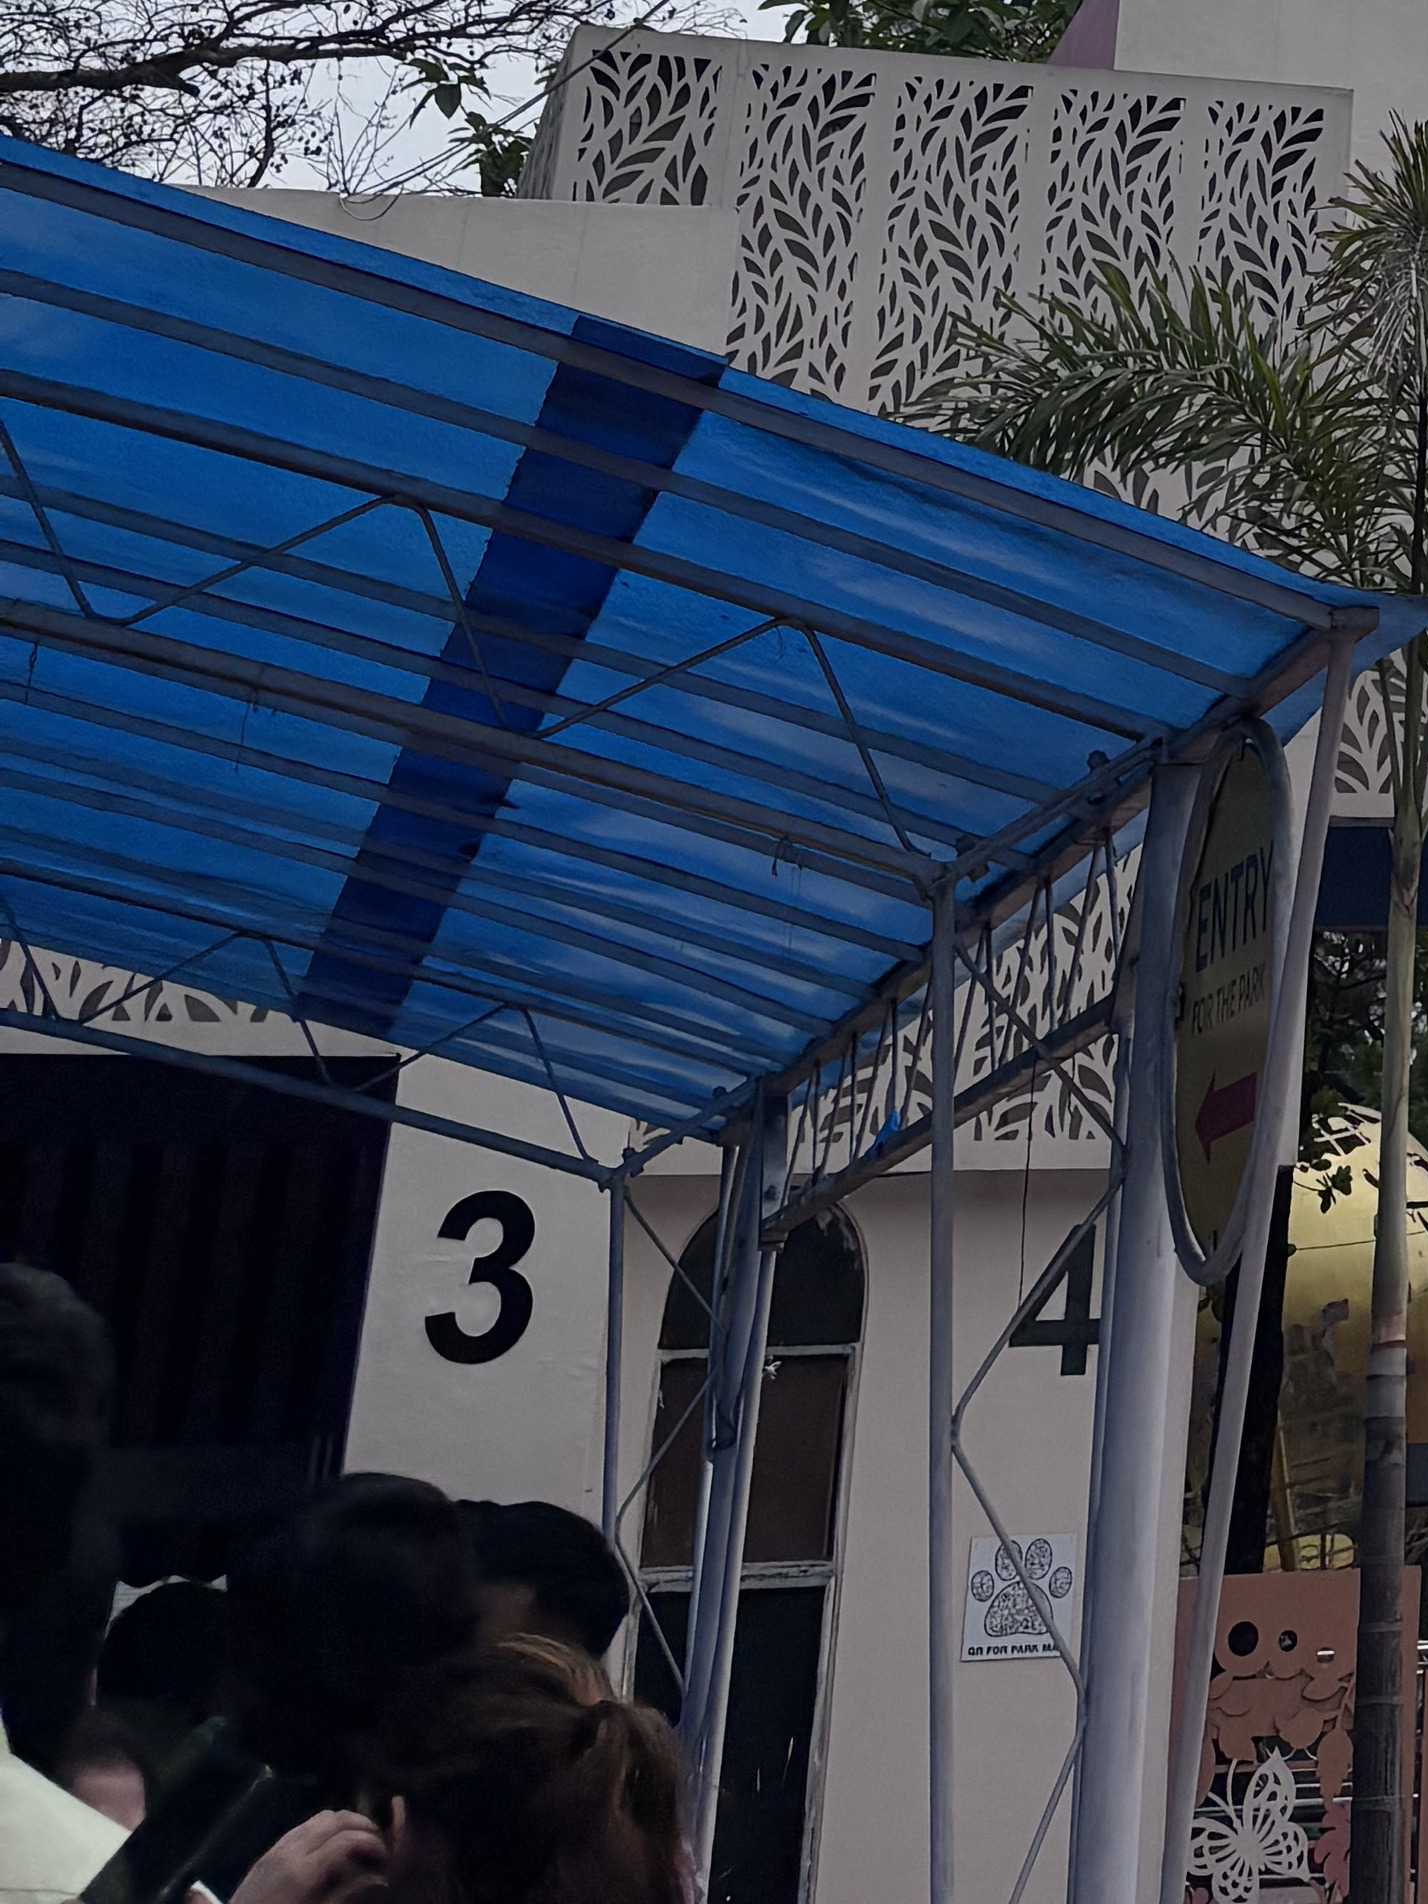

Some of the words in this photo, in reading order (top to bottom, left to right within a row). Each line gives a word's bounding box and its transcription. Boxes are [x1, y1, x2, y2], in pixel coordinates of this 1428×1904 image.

[1194, 838, 1275, 973] ENTRY
[1191, 994, 1213, 1038] FOR
[1216, 979, 1237, 1024] THE
[1238, 960, 1266, 1012] PARK
[424, 1190, 535, 1365] 3
[1008, 1224, 1102, 1376] 4
